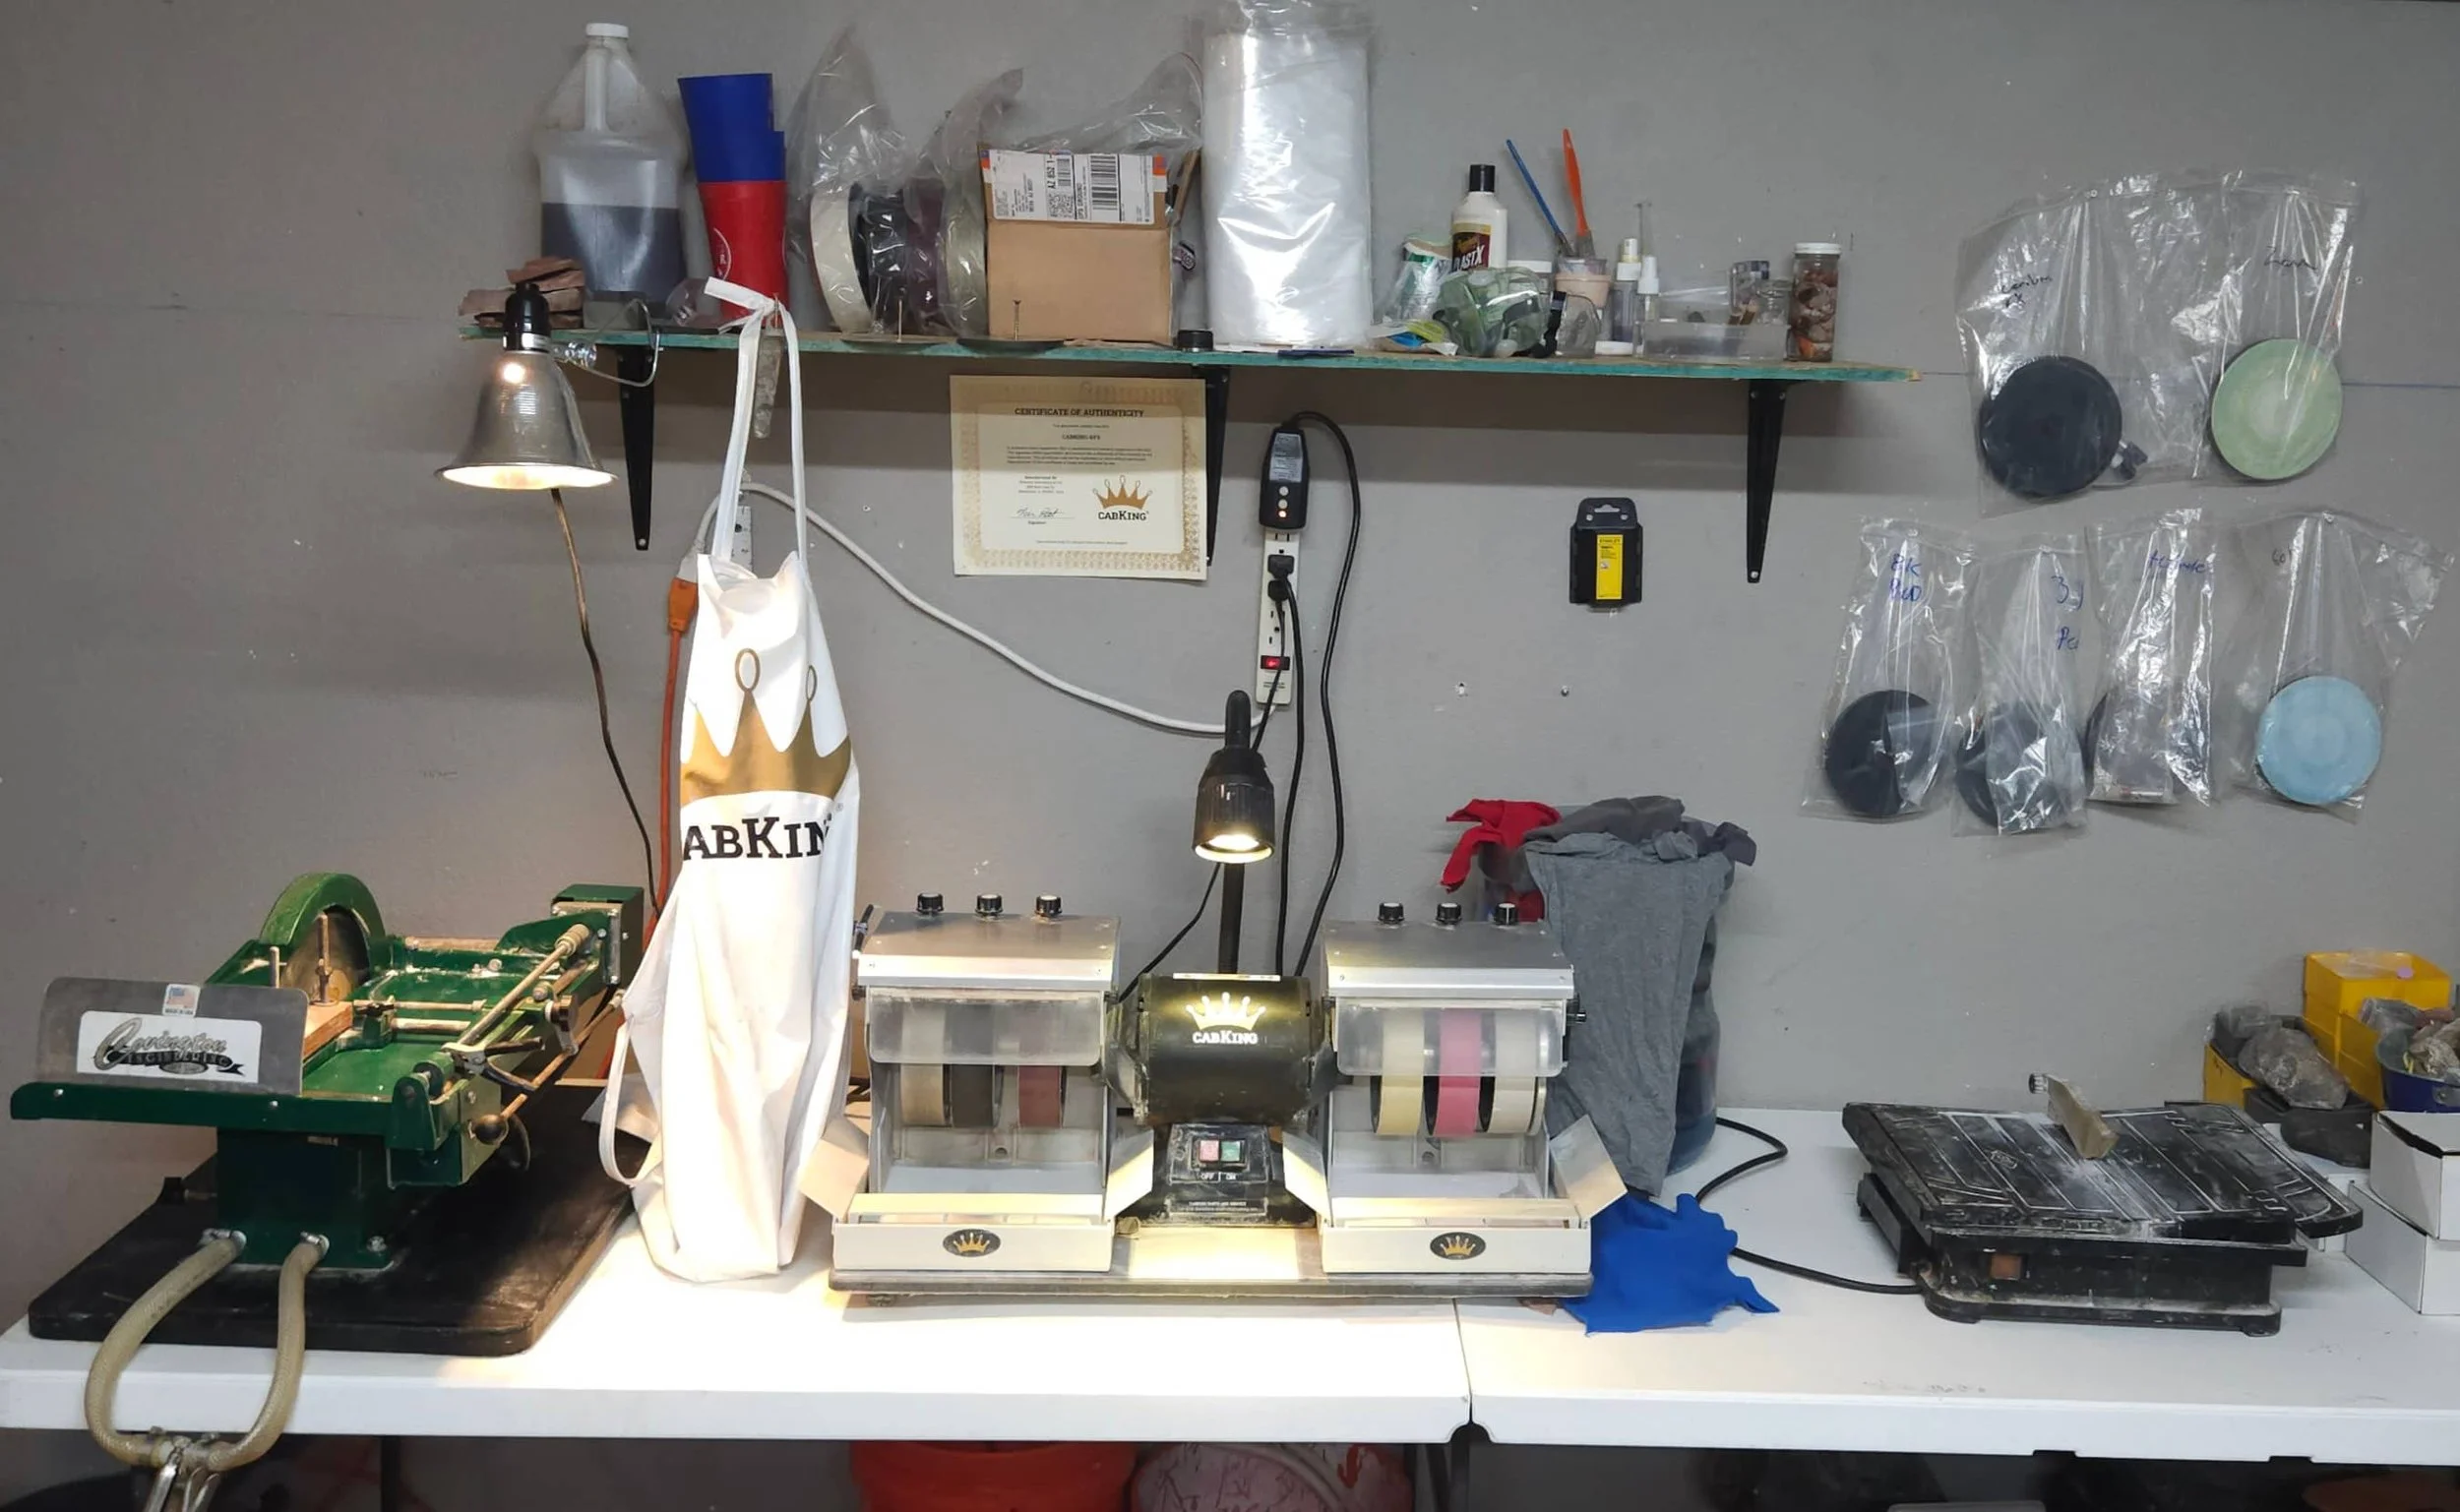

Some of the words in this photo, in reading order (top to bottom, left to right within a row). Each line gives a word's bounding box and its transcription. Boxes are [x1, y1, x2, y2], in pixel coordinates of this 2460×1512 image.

[1014, 407, 1069, 416] CERTIFICATE
[1070, 408, 1083, 417] OF
[1083, 408, 1144, 418] AUTHENTICITY
[93, 1017, 228, 1071] Covington
[1200, 1172, 1215, 1180] OFF
[1225, 1172, 1238, 1180] ON
